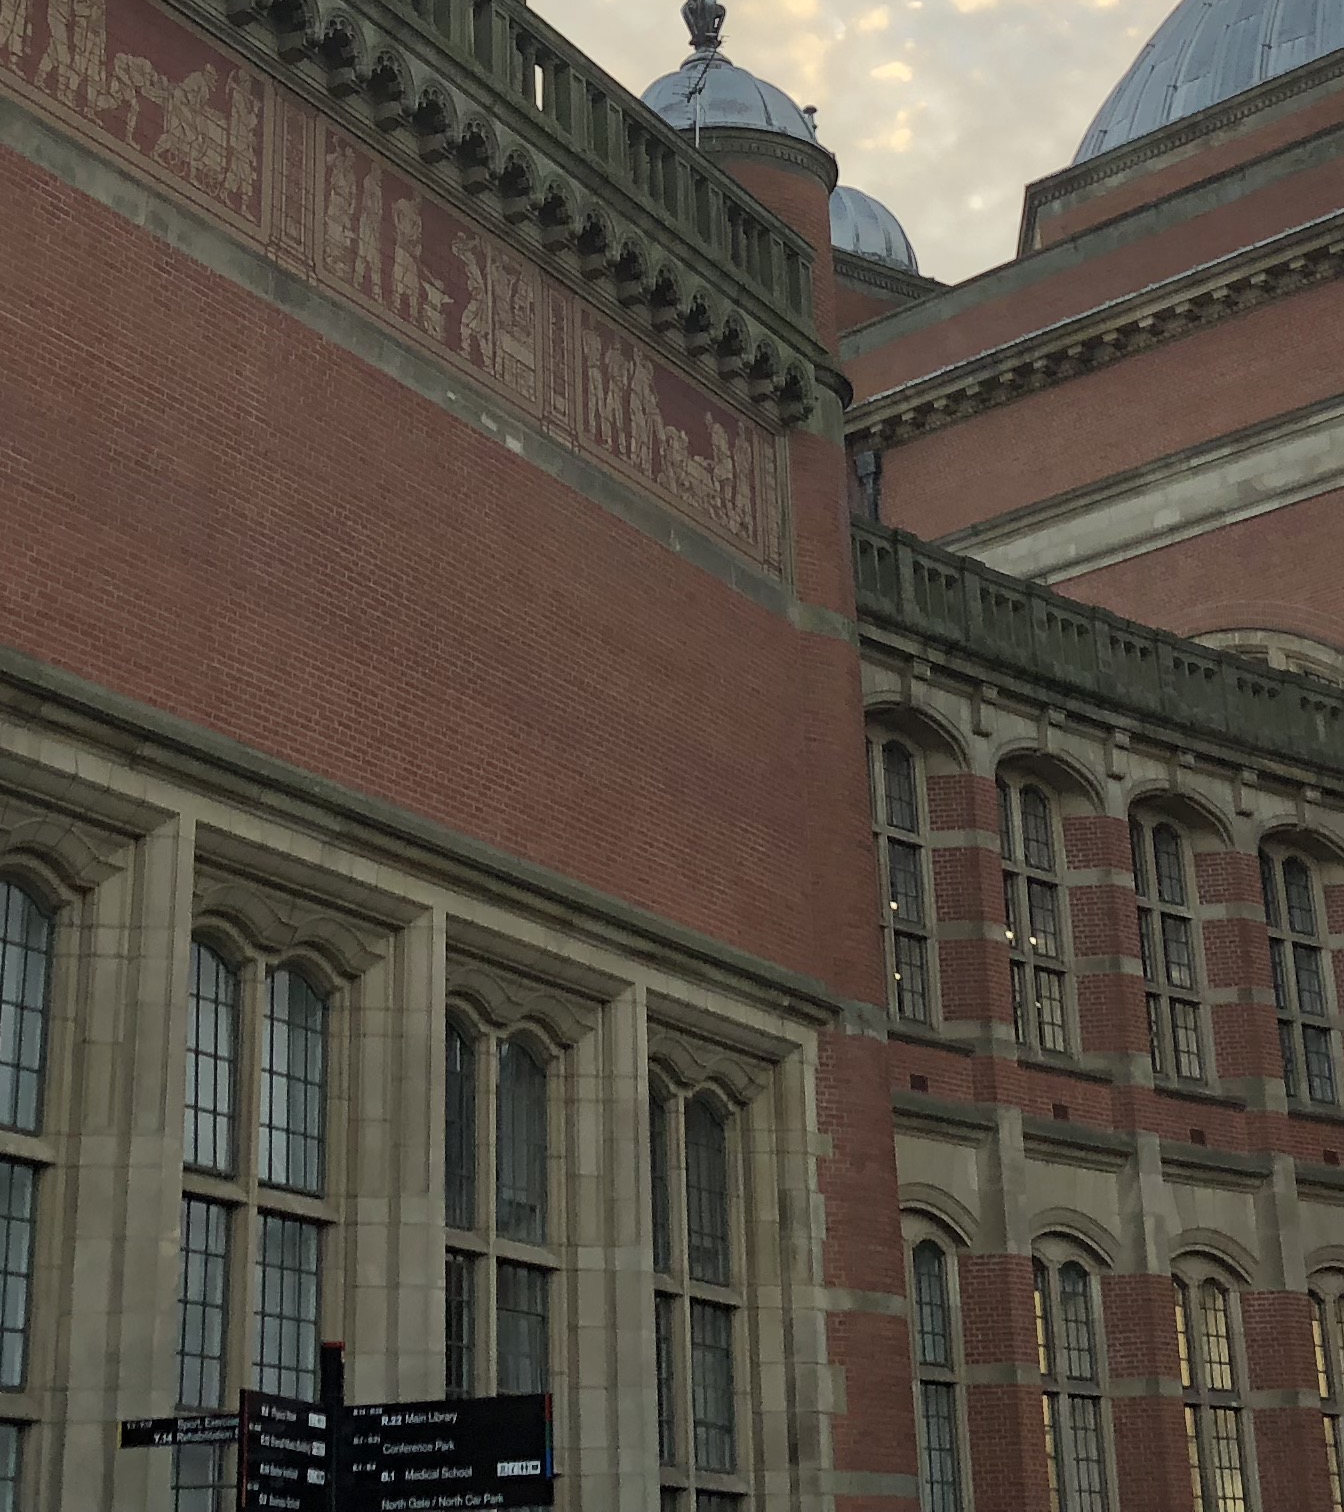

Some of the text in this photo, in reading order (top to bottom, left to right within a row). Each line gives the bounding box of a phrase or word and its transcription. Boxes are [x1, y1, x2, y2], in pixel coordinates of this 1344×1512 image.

[381, 1411, 457, 1426] R.22 Main Library
[383, 1440, 455, 1454] Conference Park
[405, 1468, 439, 1481] Medical
[441, 1466, 473, 1479] School
[382, 1498, 406, 1510] North
[408, 1498, 430, 1509] Gate
[438, 1495, 463, 1507] North
[465, 1494, 481, 1506] Car
[483, 1493, 504, 1505] Park
